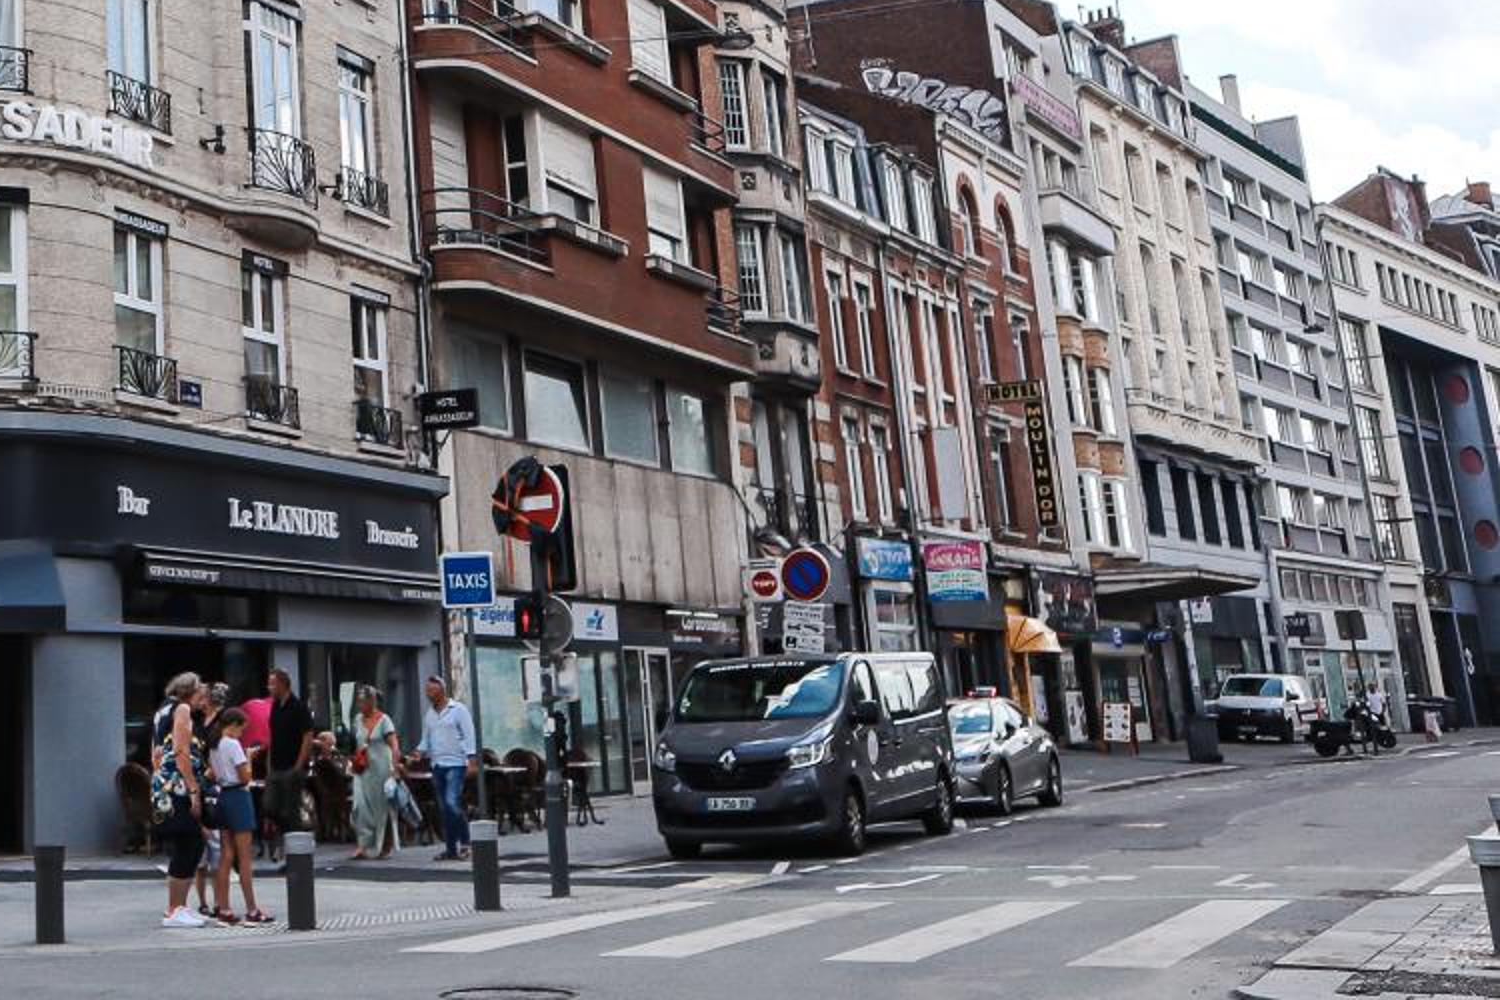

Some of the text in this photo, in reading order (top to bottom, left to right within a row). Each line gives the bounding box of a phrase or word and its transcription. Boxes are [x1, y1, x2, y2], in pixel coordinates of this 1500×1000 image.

[990, 383, 1038, 399] HOTEL
[1027, 406, 1049, 478] MOULIN
[117, 486, 419, 548] Bar Le FLANDRE Brasserie
[448, 573, 488, 589] TAXIS
